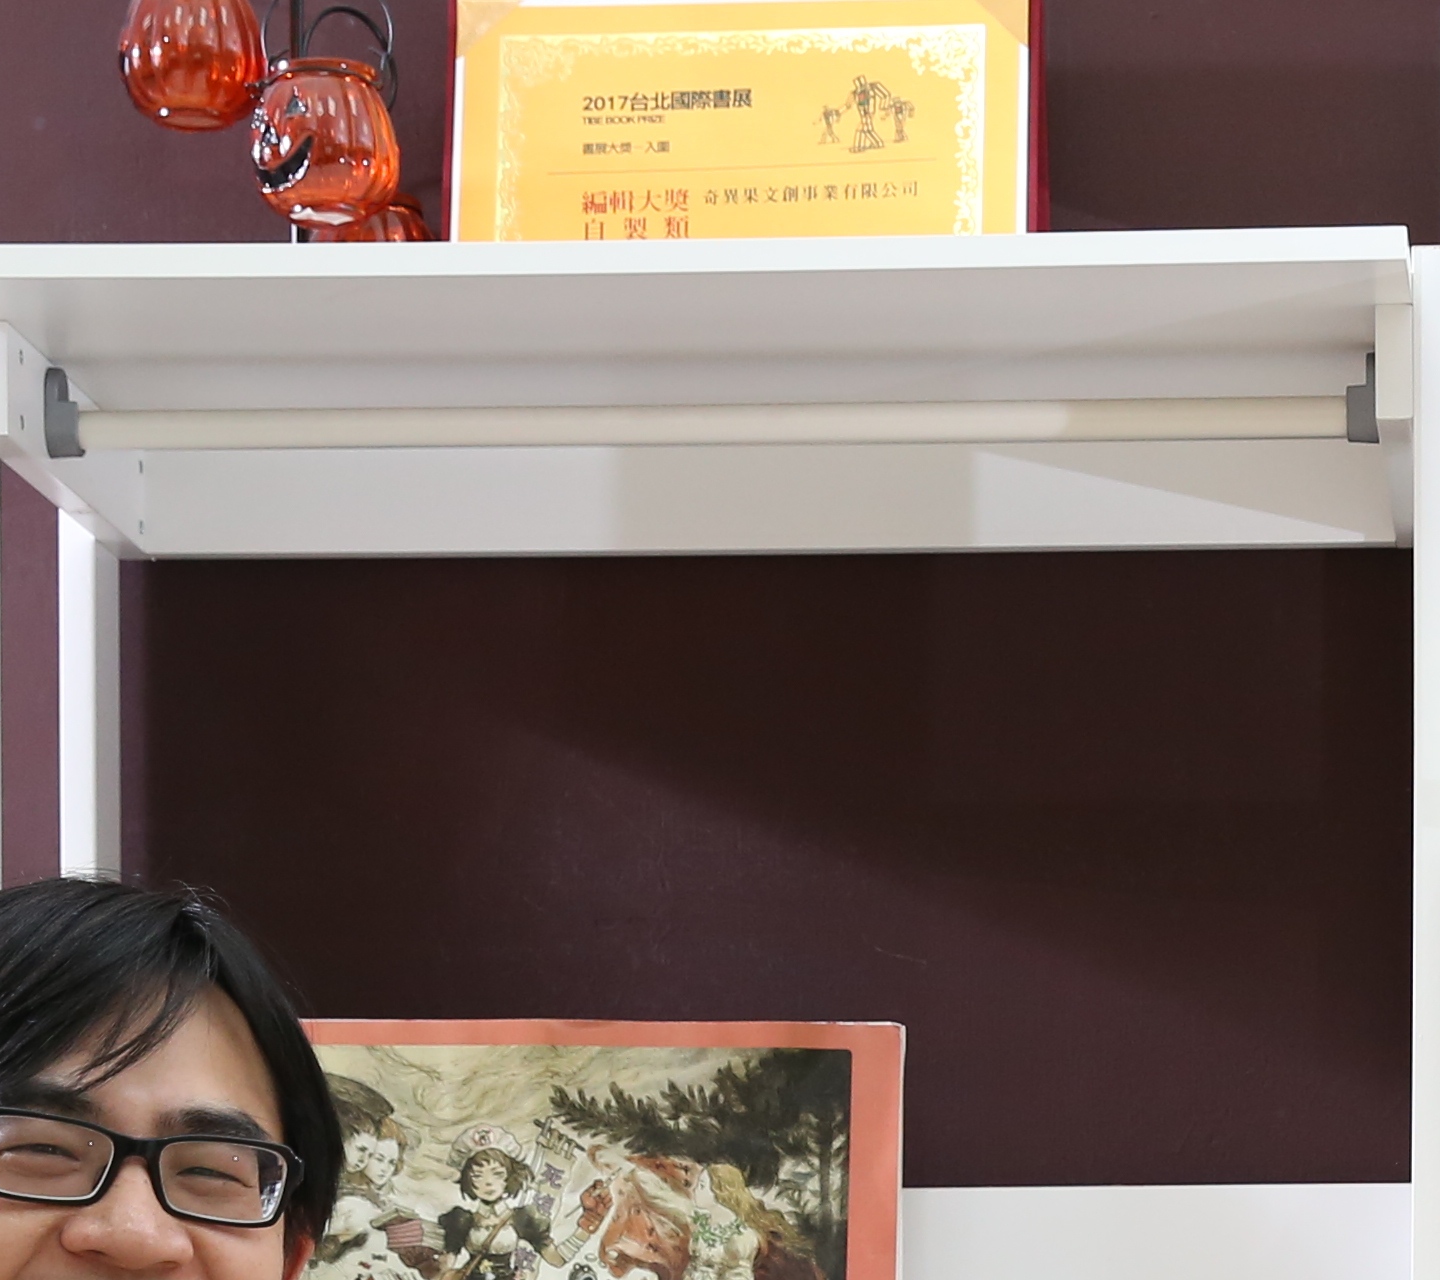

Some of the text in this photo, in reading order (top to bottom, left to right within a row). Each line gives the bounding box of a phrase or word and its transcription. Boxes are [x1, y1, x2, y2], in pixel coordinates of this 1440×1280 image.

[582, 89, 753, 113] 2017台北國際書展
[581, 188, 691, 216] 編輯大獎
[703, 180, 920, 207] 奇異果文創事業有限公司
[583, 215, 691, 241] 自製類
